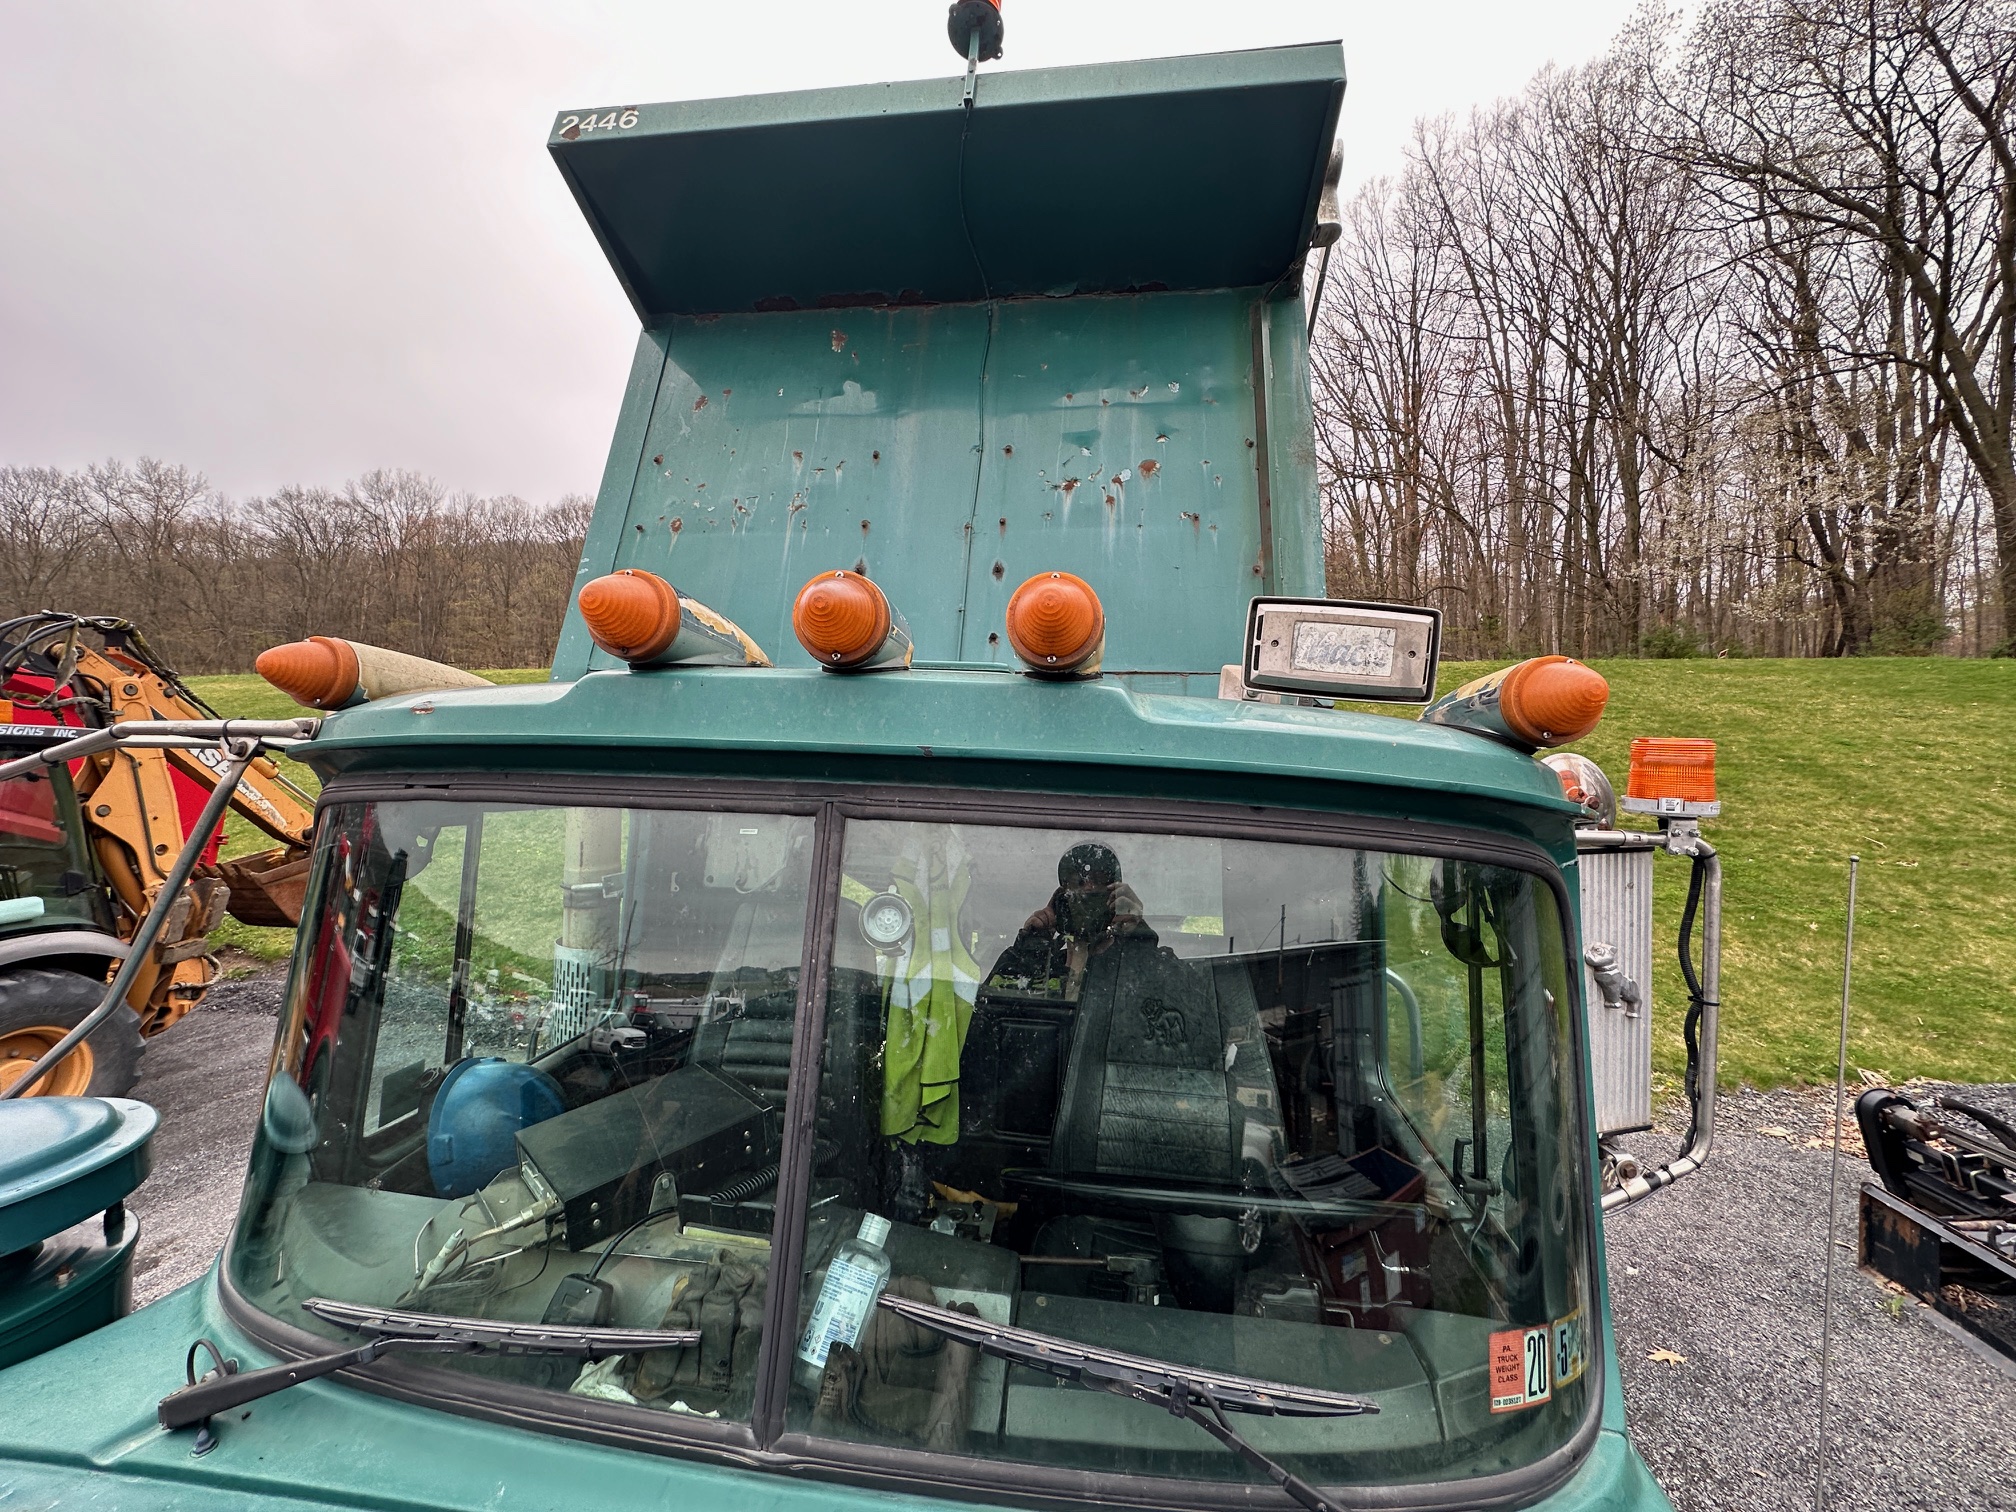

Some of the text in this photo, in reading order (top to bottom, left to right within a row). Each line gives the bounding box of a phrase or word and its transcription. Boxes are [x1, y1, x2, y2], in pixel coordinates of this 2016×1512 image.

[559, 110, 639, 135] 2446
[0, 725, 79, 738] SIGNS INC.
[1497, 1354, 1518, 1363] TRUCK
[1495, 1364, 1520, 1374] WEIGHT
[1527, 1333, 1547, 1397] 20
[1498, 1374, 1518, 1383] CLASS
